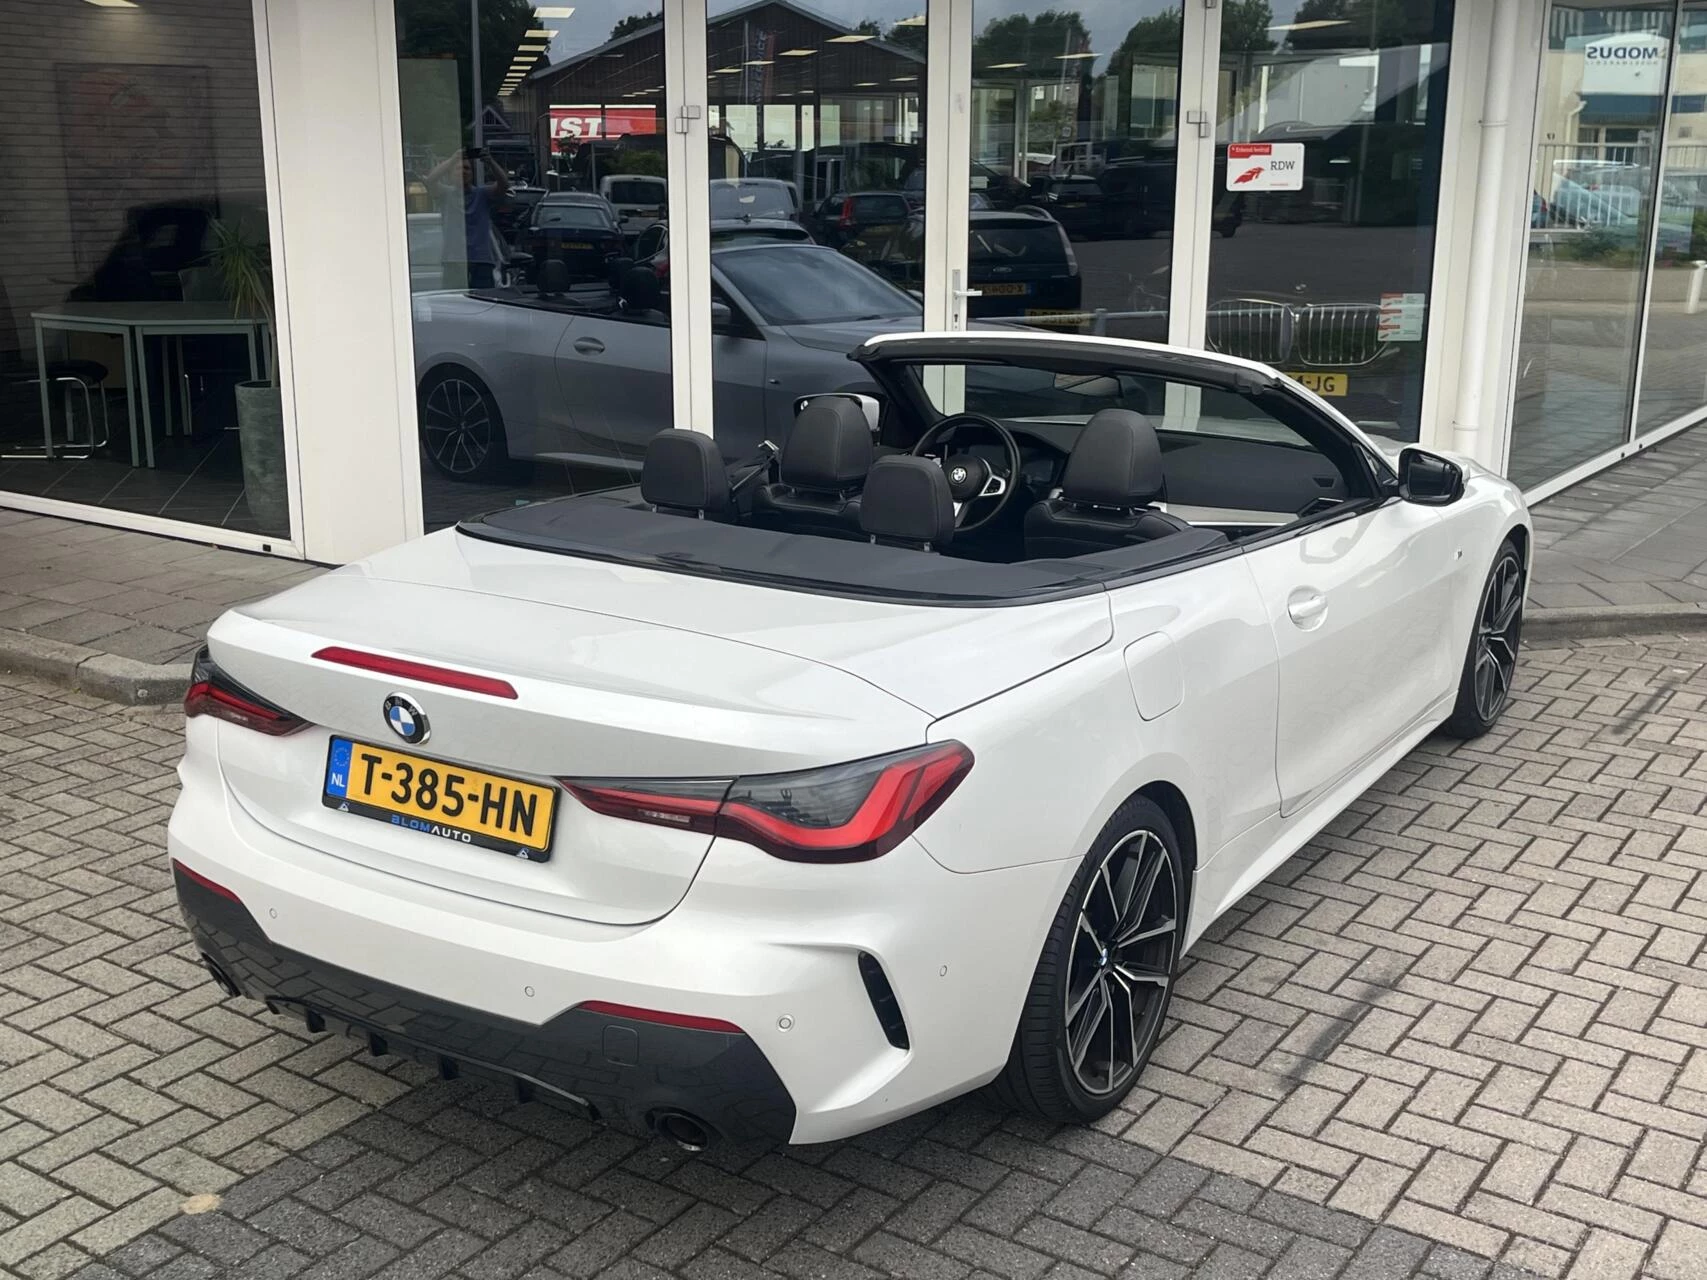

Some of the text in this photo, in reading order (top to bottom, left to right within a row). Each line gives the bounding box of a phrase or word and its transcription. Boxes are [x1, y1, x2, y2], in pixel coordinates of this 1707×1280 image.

[1270, 161, 1295, 171] RDW
[331, 772, 346, 788] NL
[361, 754, 537, 837] T-385-HN
